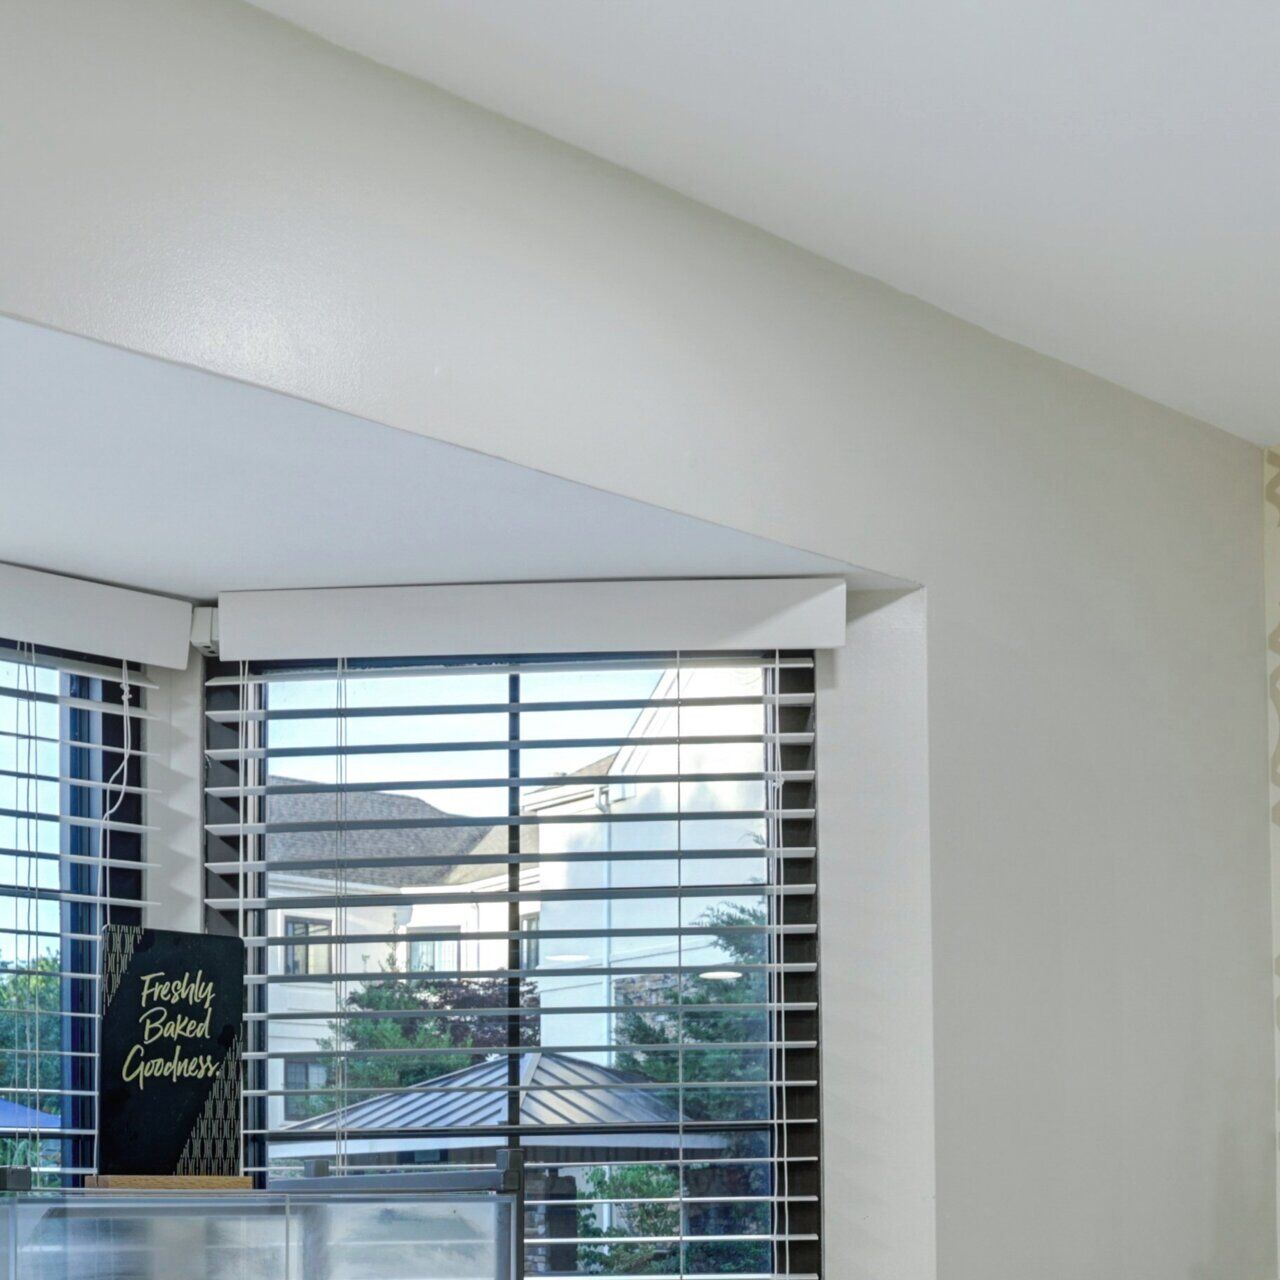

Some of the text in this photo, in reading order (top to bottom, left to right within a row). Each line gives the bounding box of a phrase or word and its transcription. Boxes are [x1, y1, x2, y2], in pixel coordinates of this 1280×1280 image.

[140, 969, 216, 1009] Freshly
[139, 1006, 212, 1045] Baked
[122, 1044, 220, 1090] Goodness.
